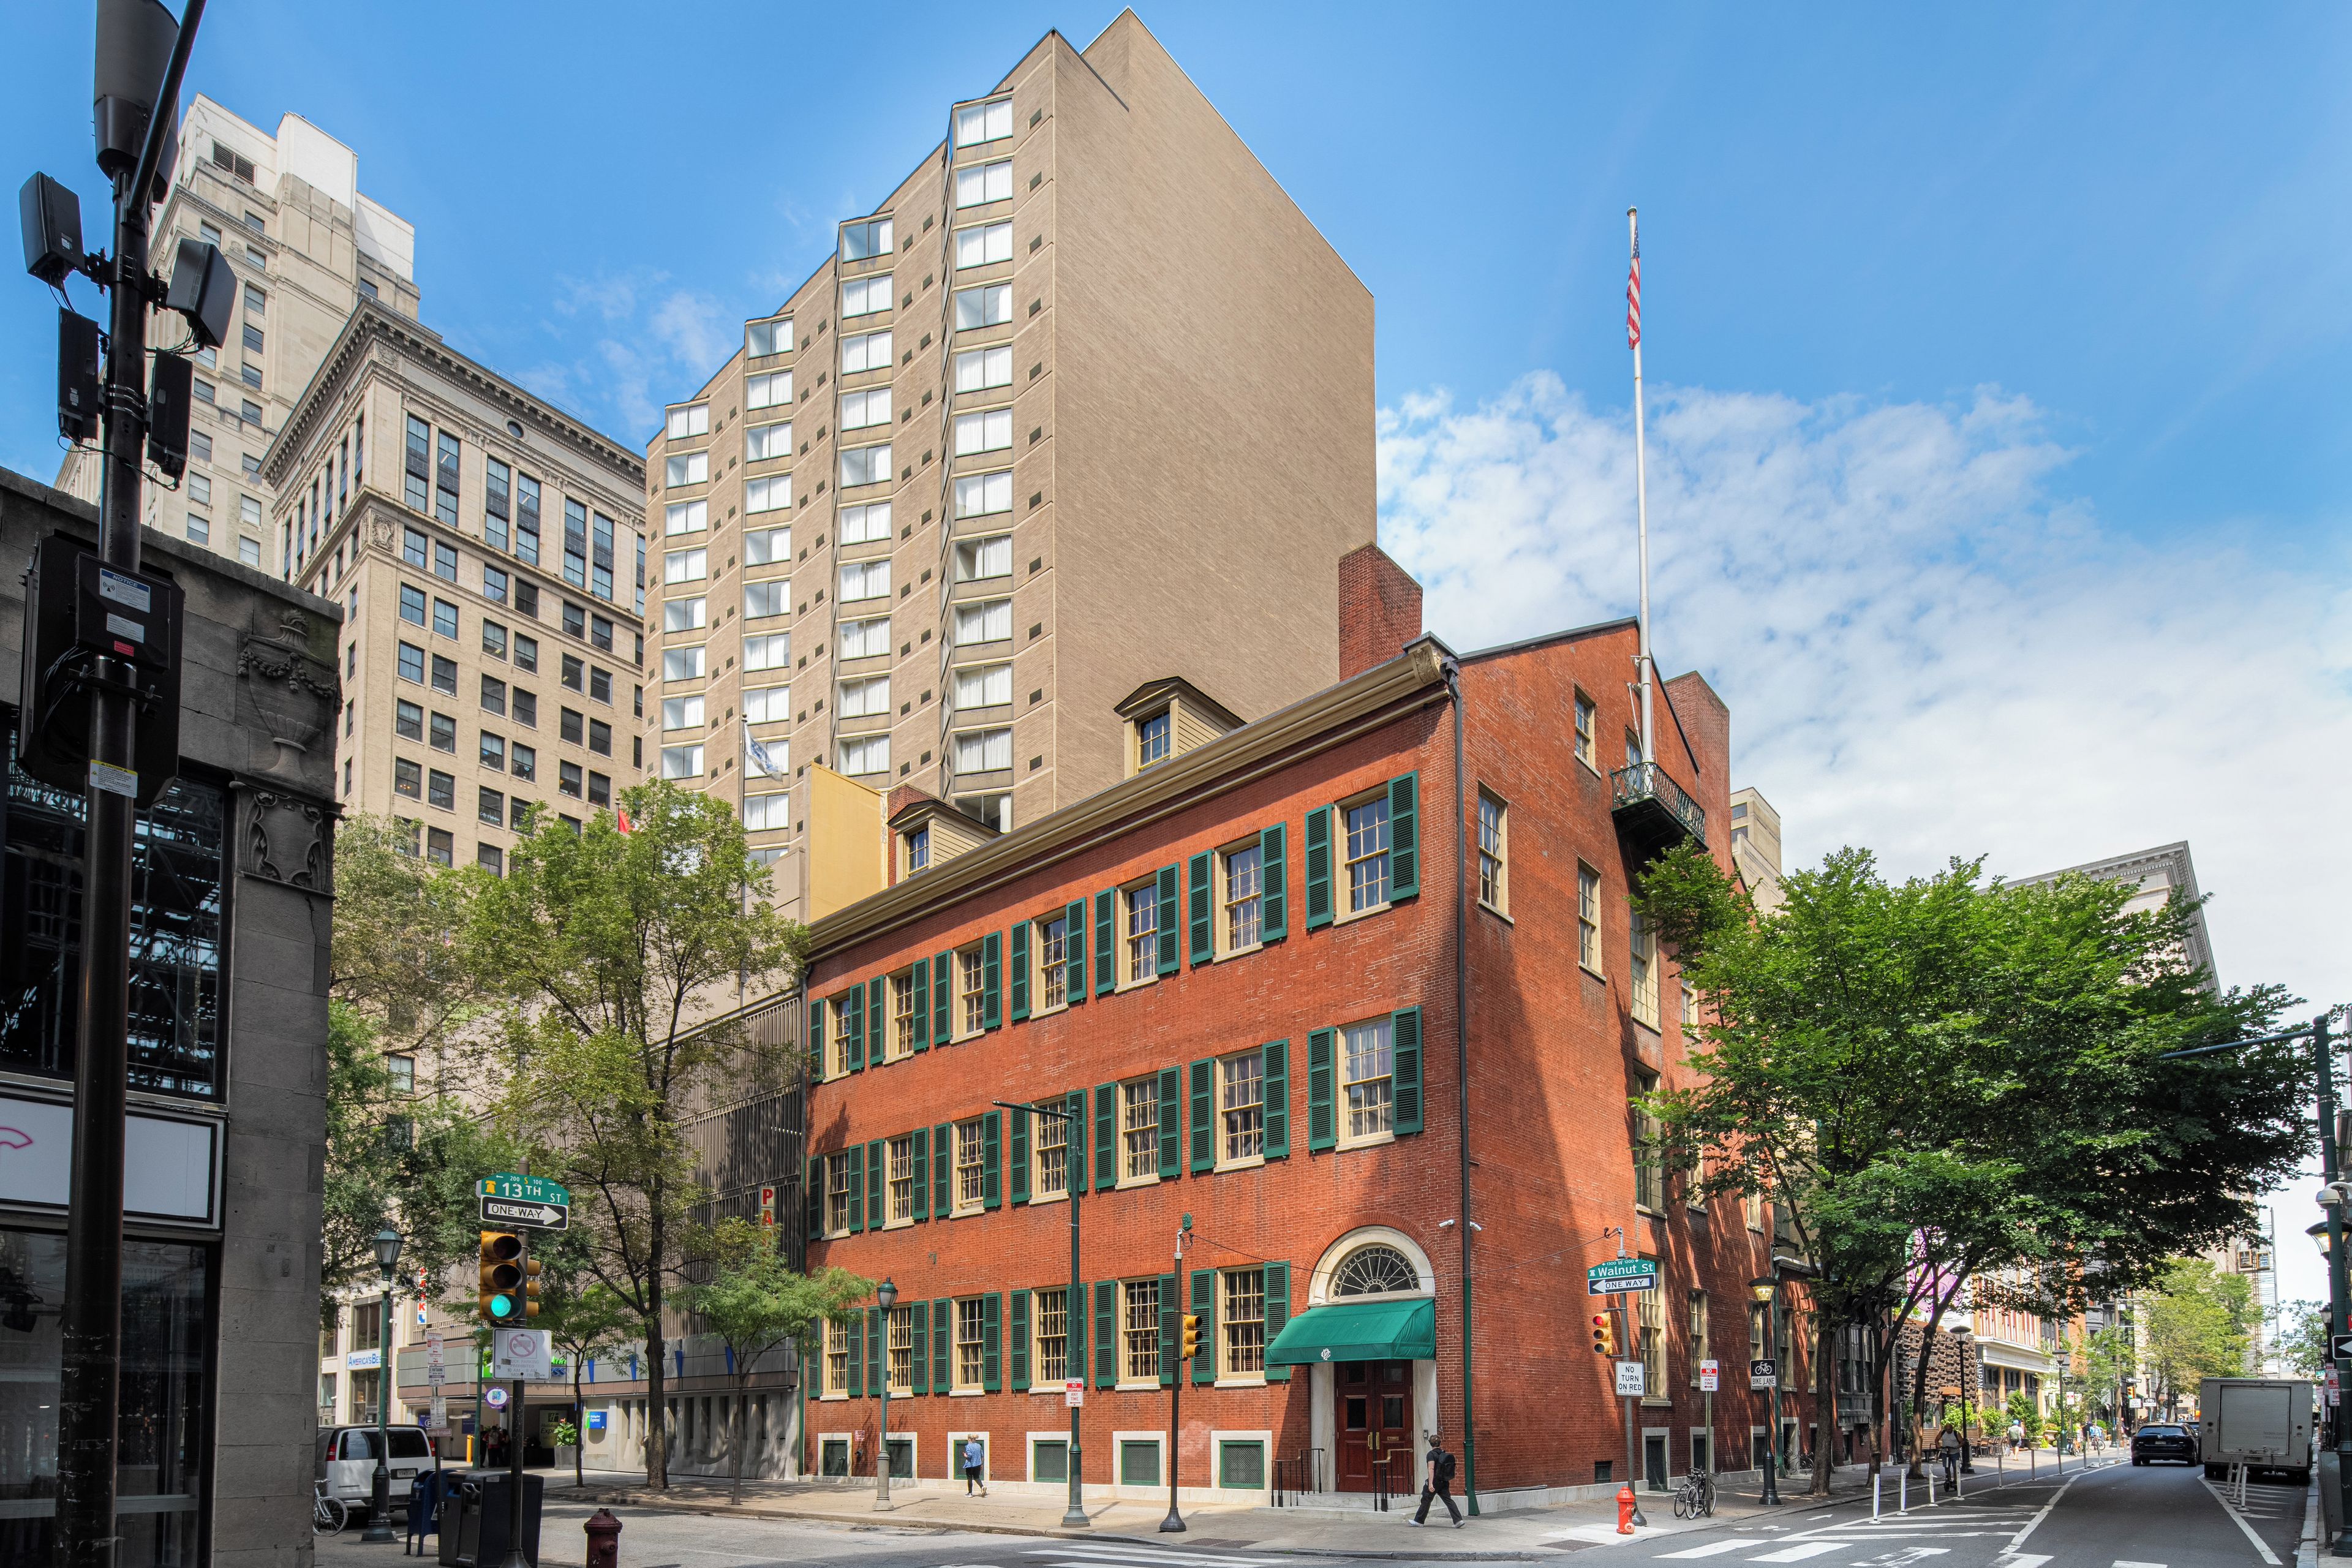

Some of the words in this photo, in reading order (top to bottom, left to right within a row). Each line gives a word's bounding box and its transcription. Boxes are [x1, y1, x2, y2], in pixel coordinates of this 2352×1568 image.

[113, 575, 138, 588] NOTICE
[550, 1193, 561, 1203] ST
[492, 1205, 514, 1215] ONE
[519, 1209, 543, 1218] WAY
[1598, 1264, 1637, 1276] Walnut
[1642, 1263, 1653, 1272] St
